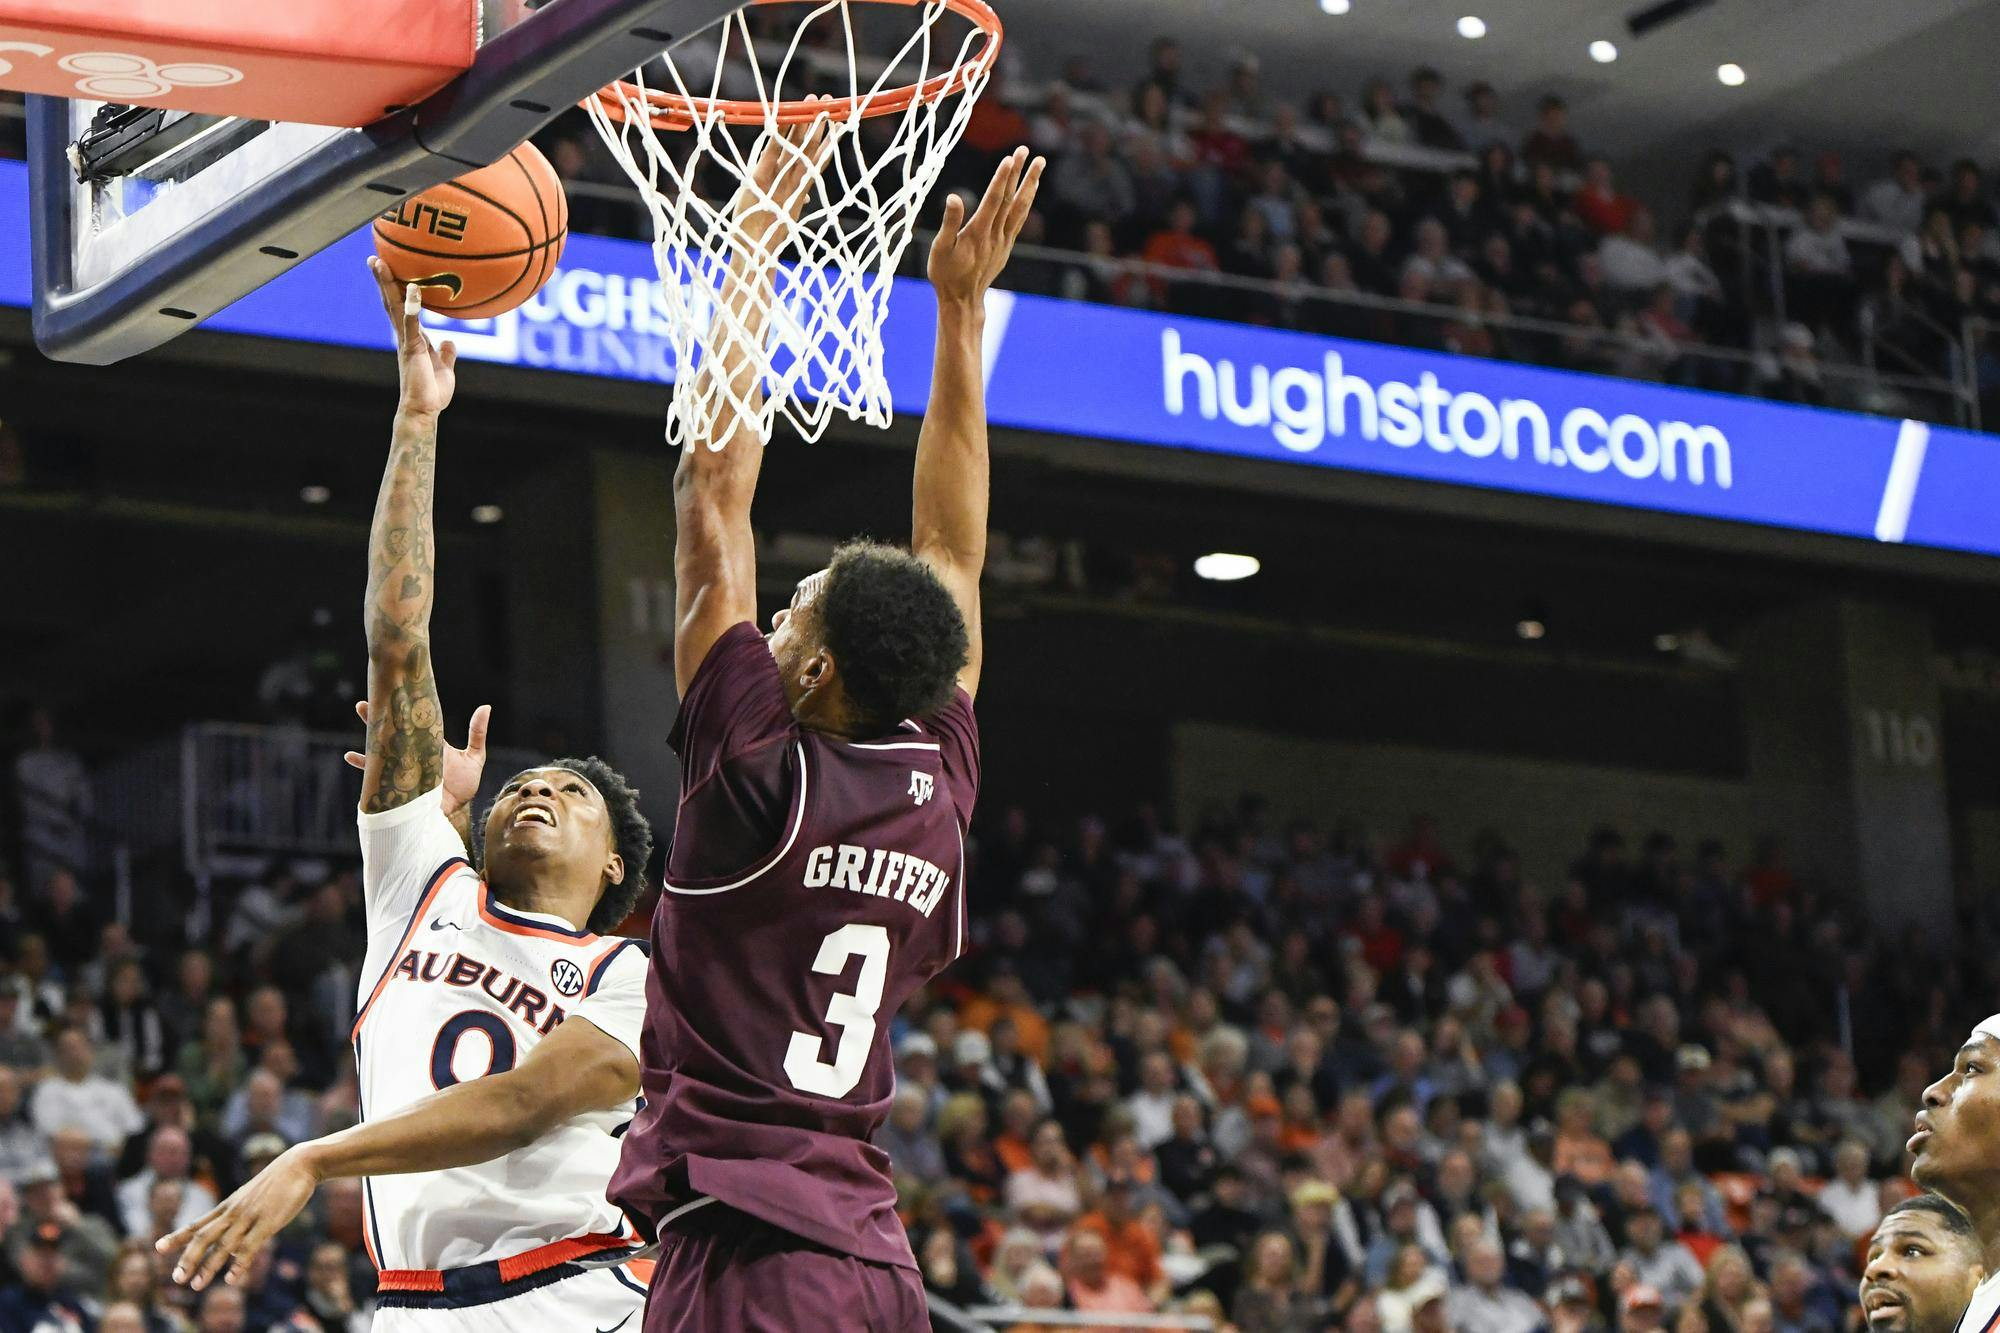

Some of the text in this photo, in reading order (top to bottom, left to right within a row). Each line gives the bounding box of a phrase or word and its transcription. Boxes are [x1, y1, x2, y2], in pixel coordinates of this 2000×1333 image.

[1162, 328, 1732, 489] hughston.com
[803, 844, 950, 919] GRIFFEN
[552, 960, 583, 996] SEC
[783, 923, 891, 1099] 3
[429, 1009, 517, 1091] 0
